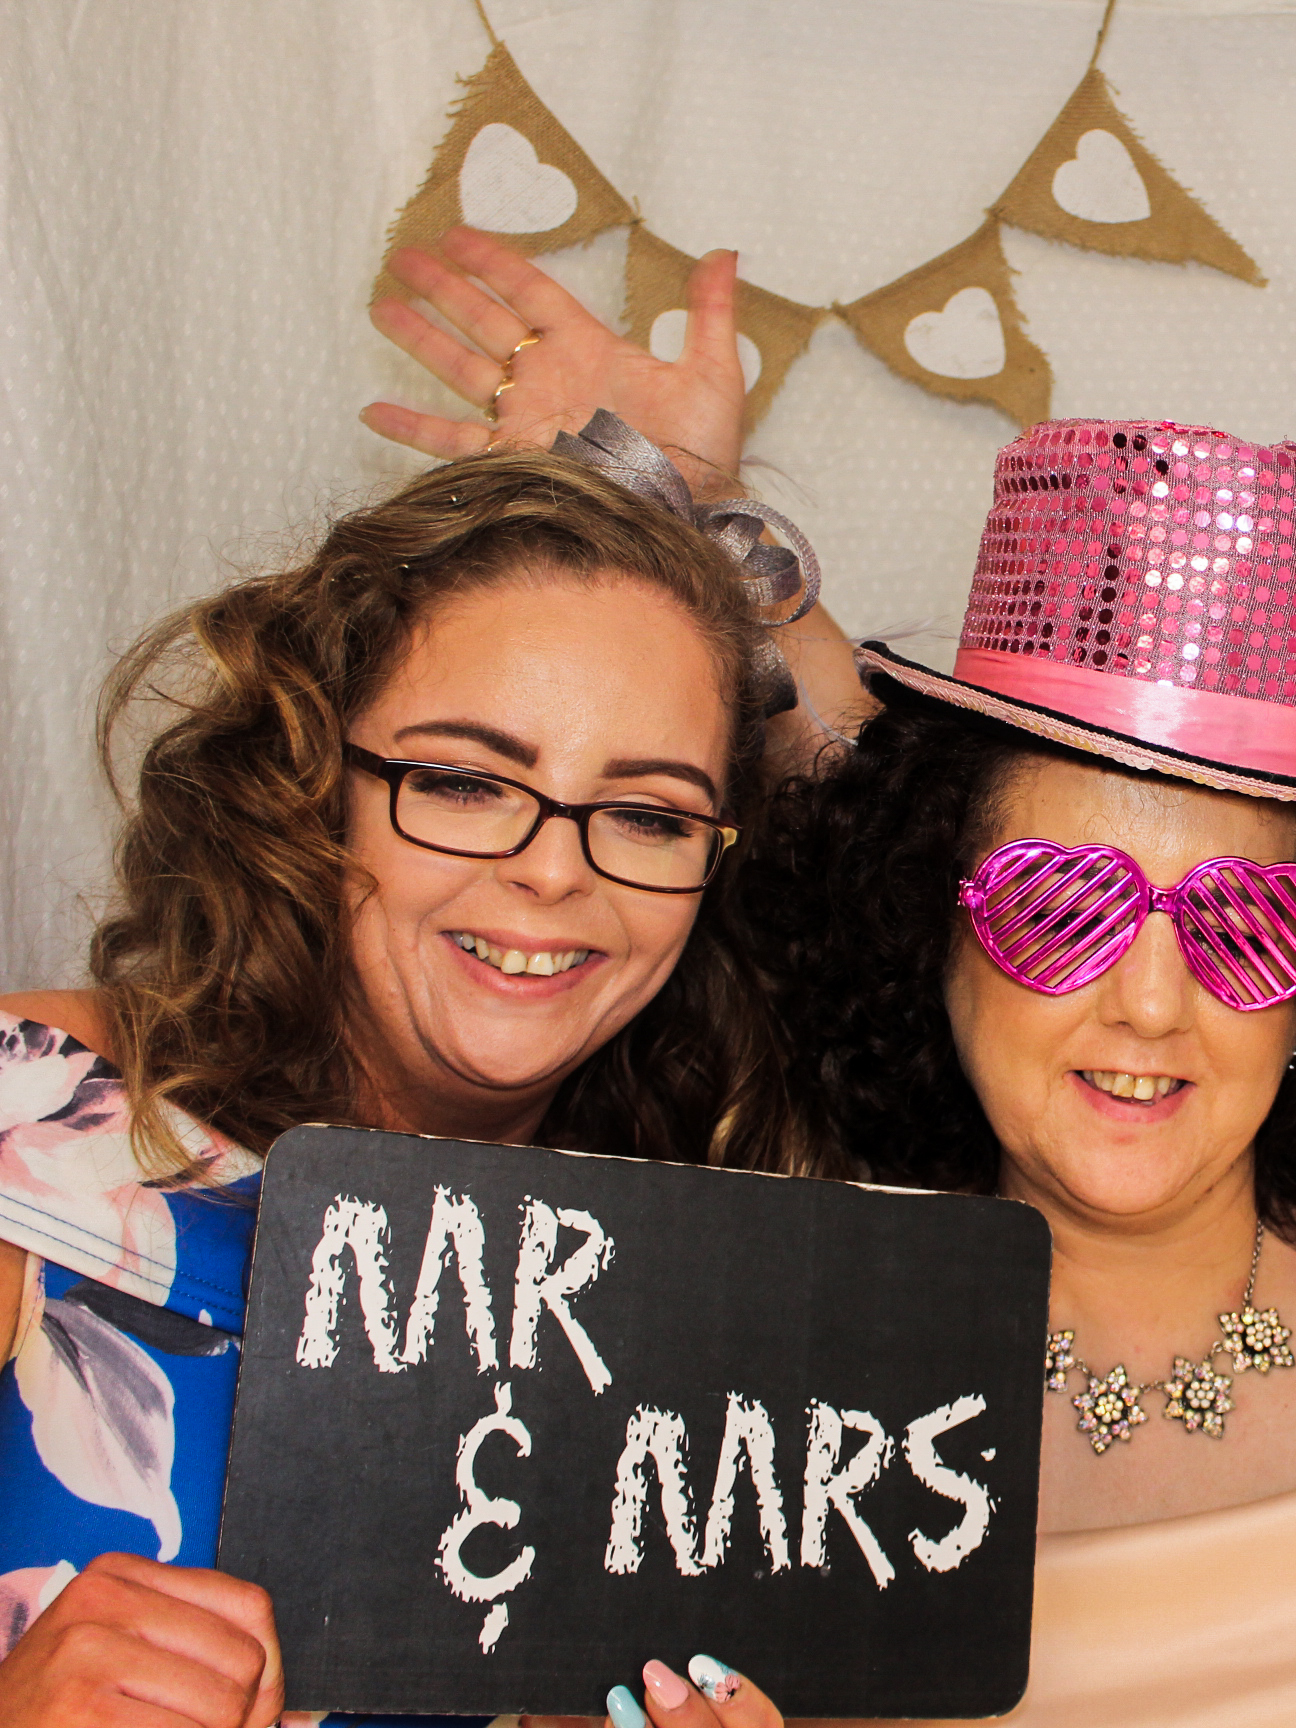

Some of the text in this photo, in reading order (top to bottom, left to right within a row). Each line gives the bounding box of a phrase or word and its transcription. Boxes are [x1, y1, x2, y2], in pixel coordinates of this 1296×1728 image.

[295, 1184, 616, 1395] MR
[434, 1381, 1000, 1653] & MRS
